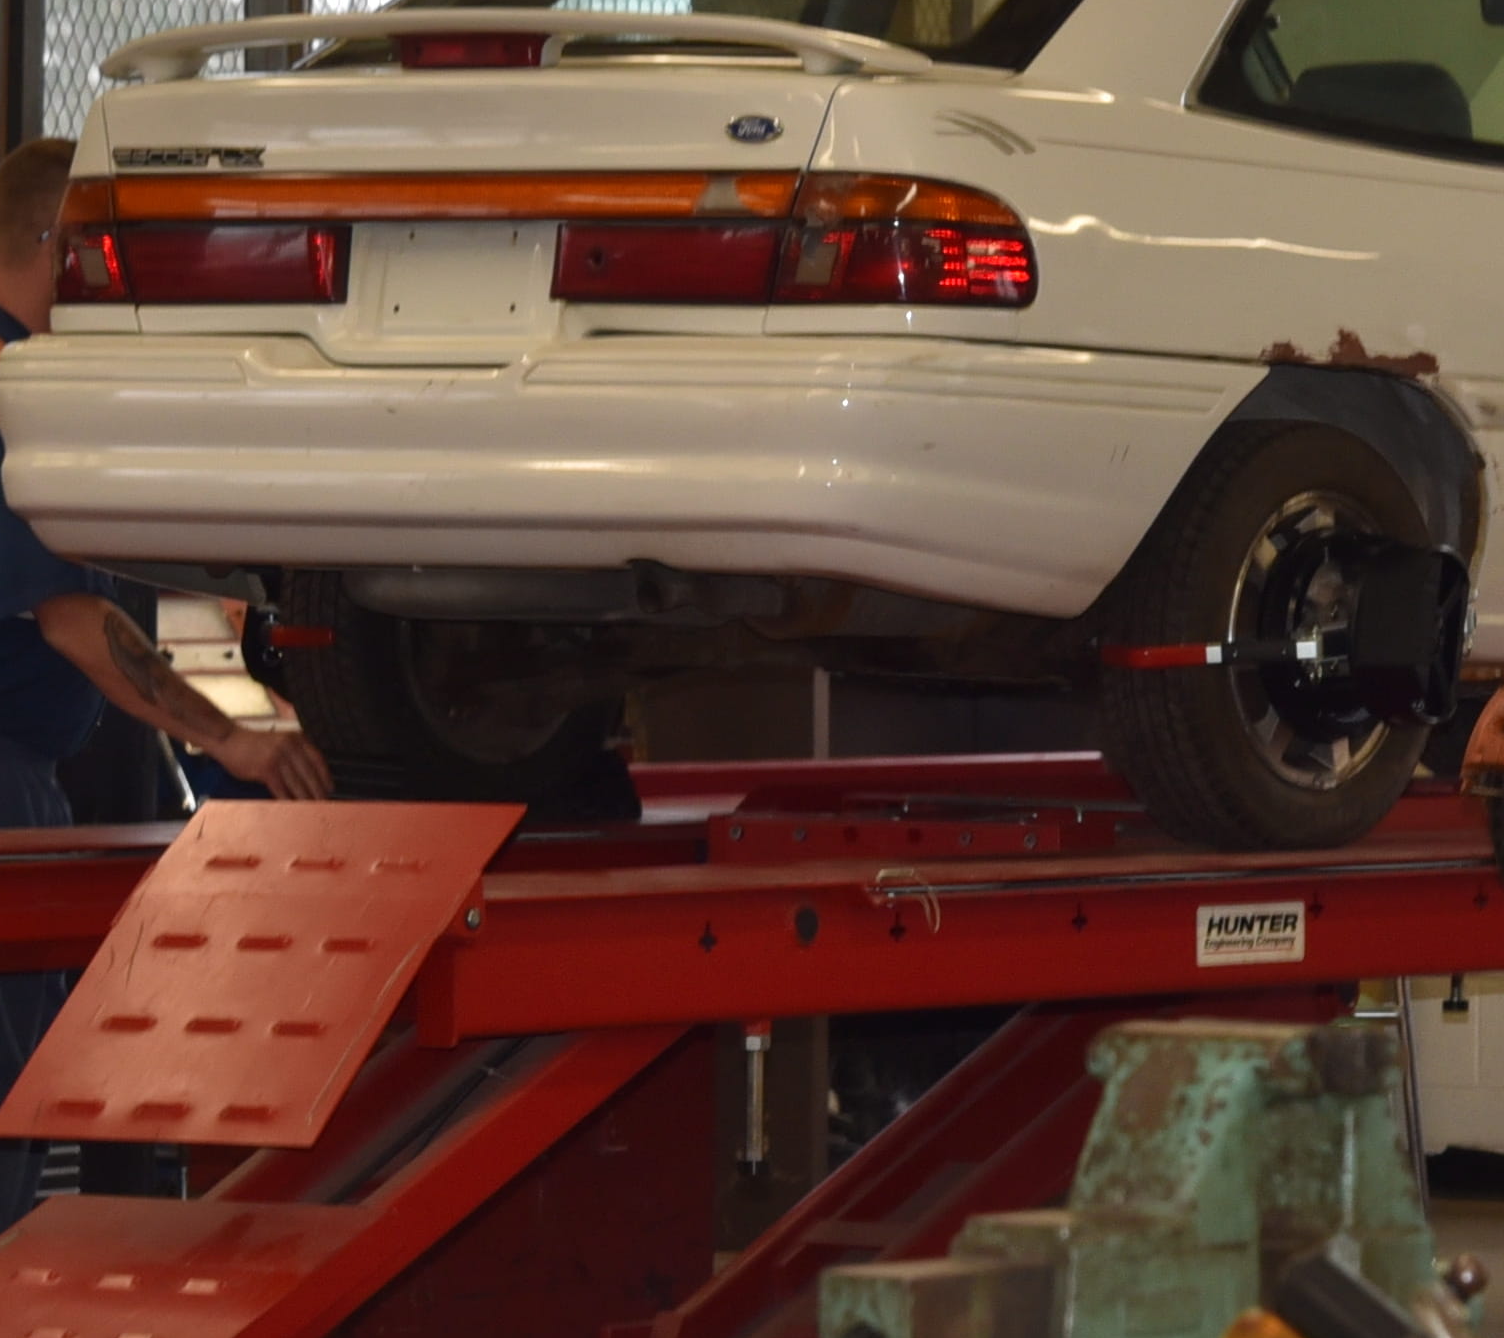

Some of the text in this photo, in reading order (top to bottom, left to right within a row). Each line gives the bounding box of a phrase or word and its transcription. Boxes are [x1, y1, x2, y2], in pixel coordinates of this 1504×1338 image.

[1206, 913, 1299, 937] HUNTER
[1205, 935, 1295, 951] Engineering Company
